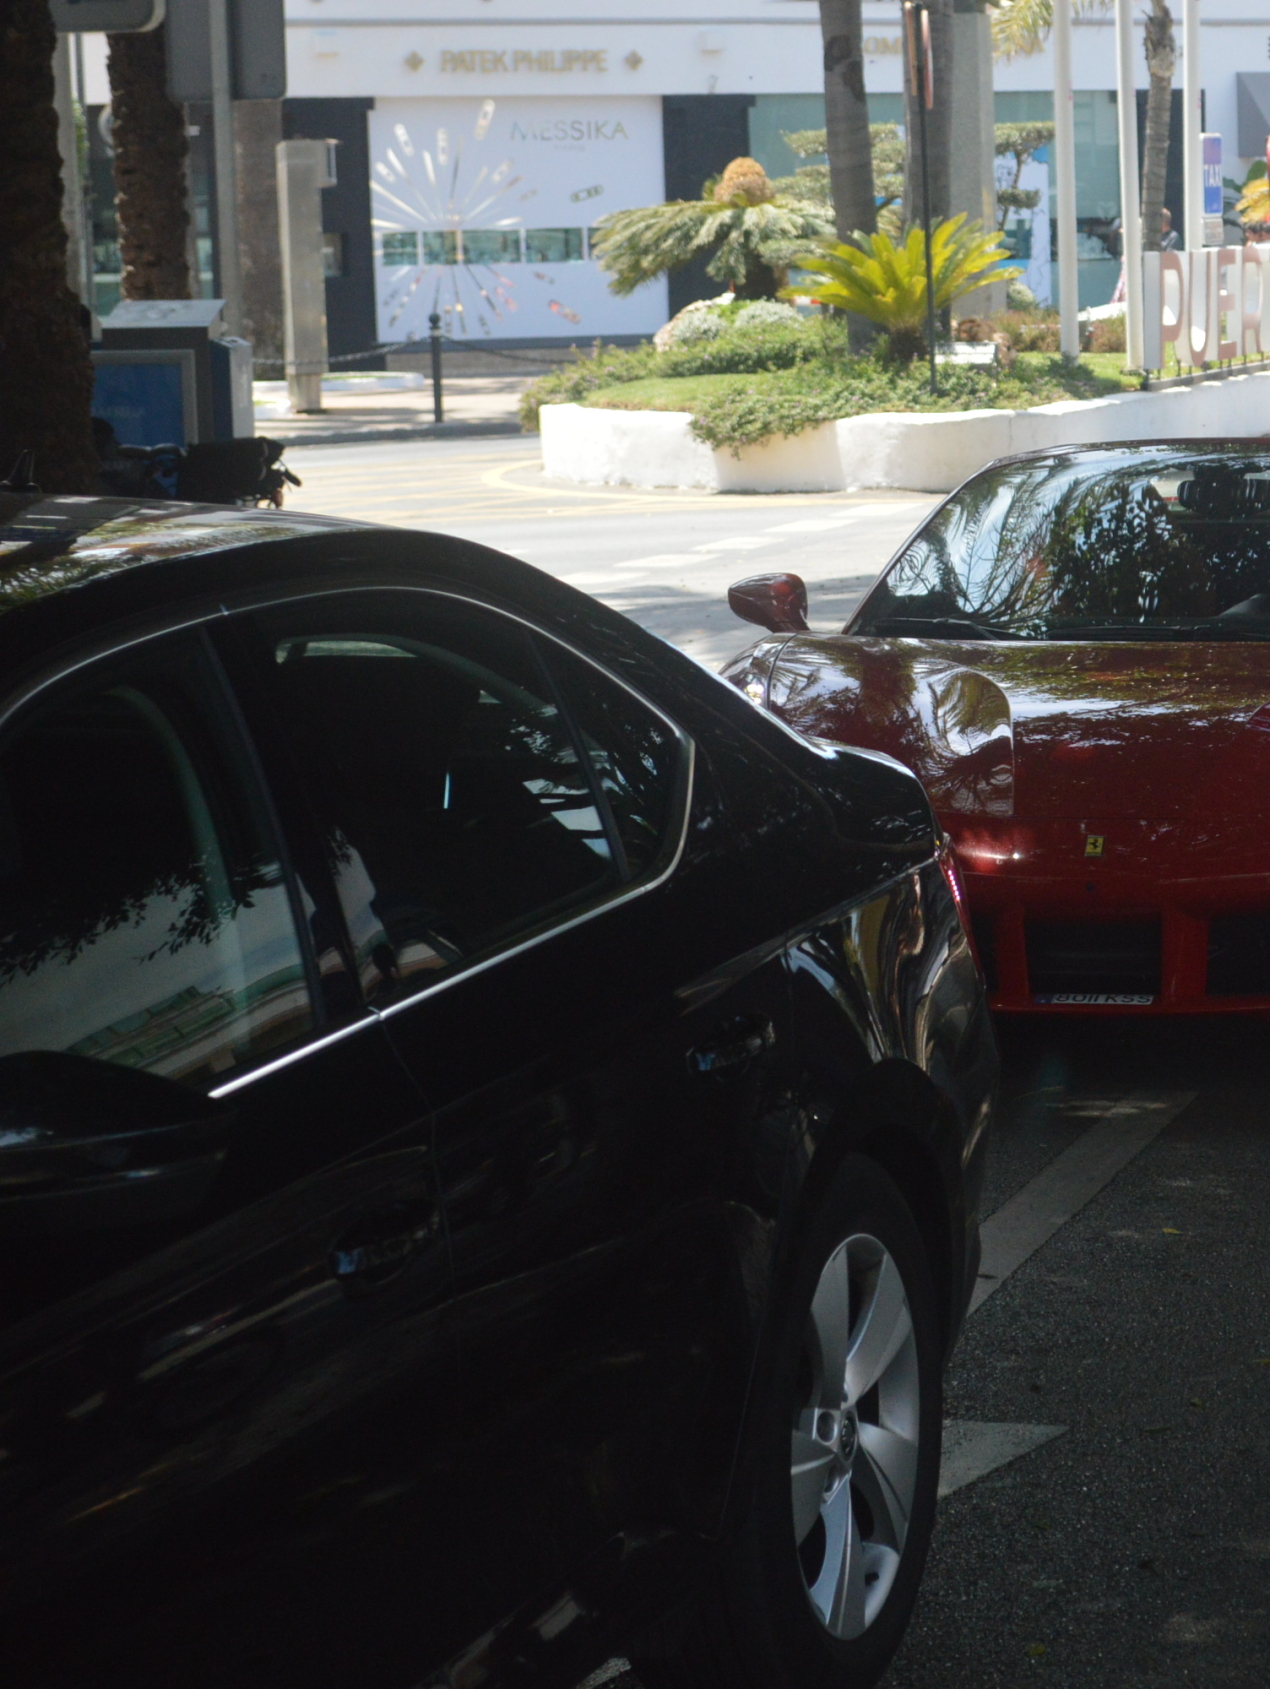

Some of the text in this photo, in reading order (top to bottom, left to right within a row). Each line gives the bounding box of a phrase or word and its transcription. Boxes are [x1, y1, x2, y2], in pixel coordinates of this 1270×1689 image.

[442, 50, 607, 73] PATEK PHILIPPE
[510, 120, 629, 141] MESSIKA
